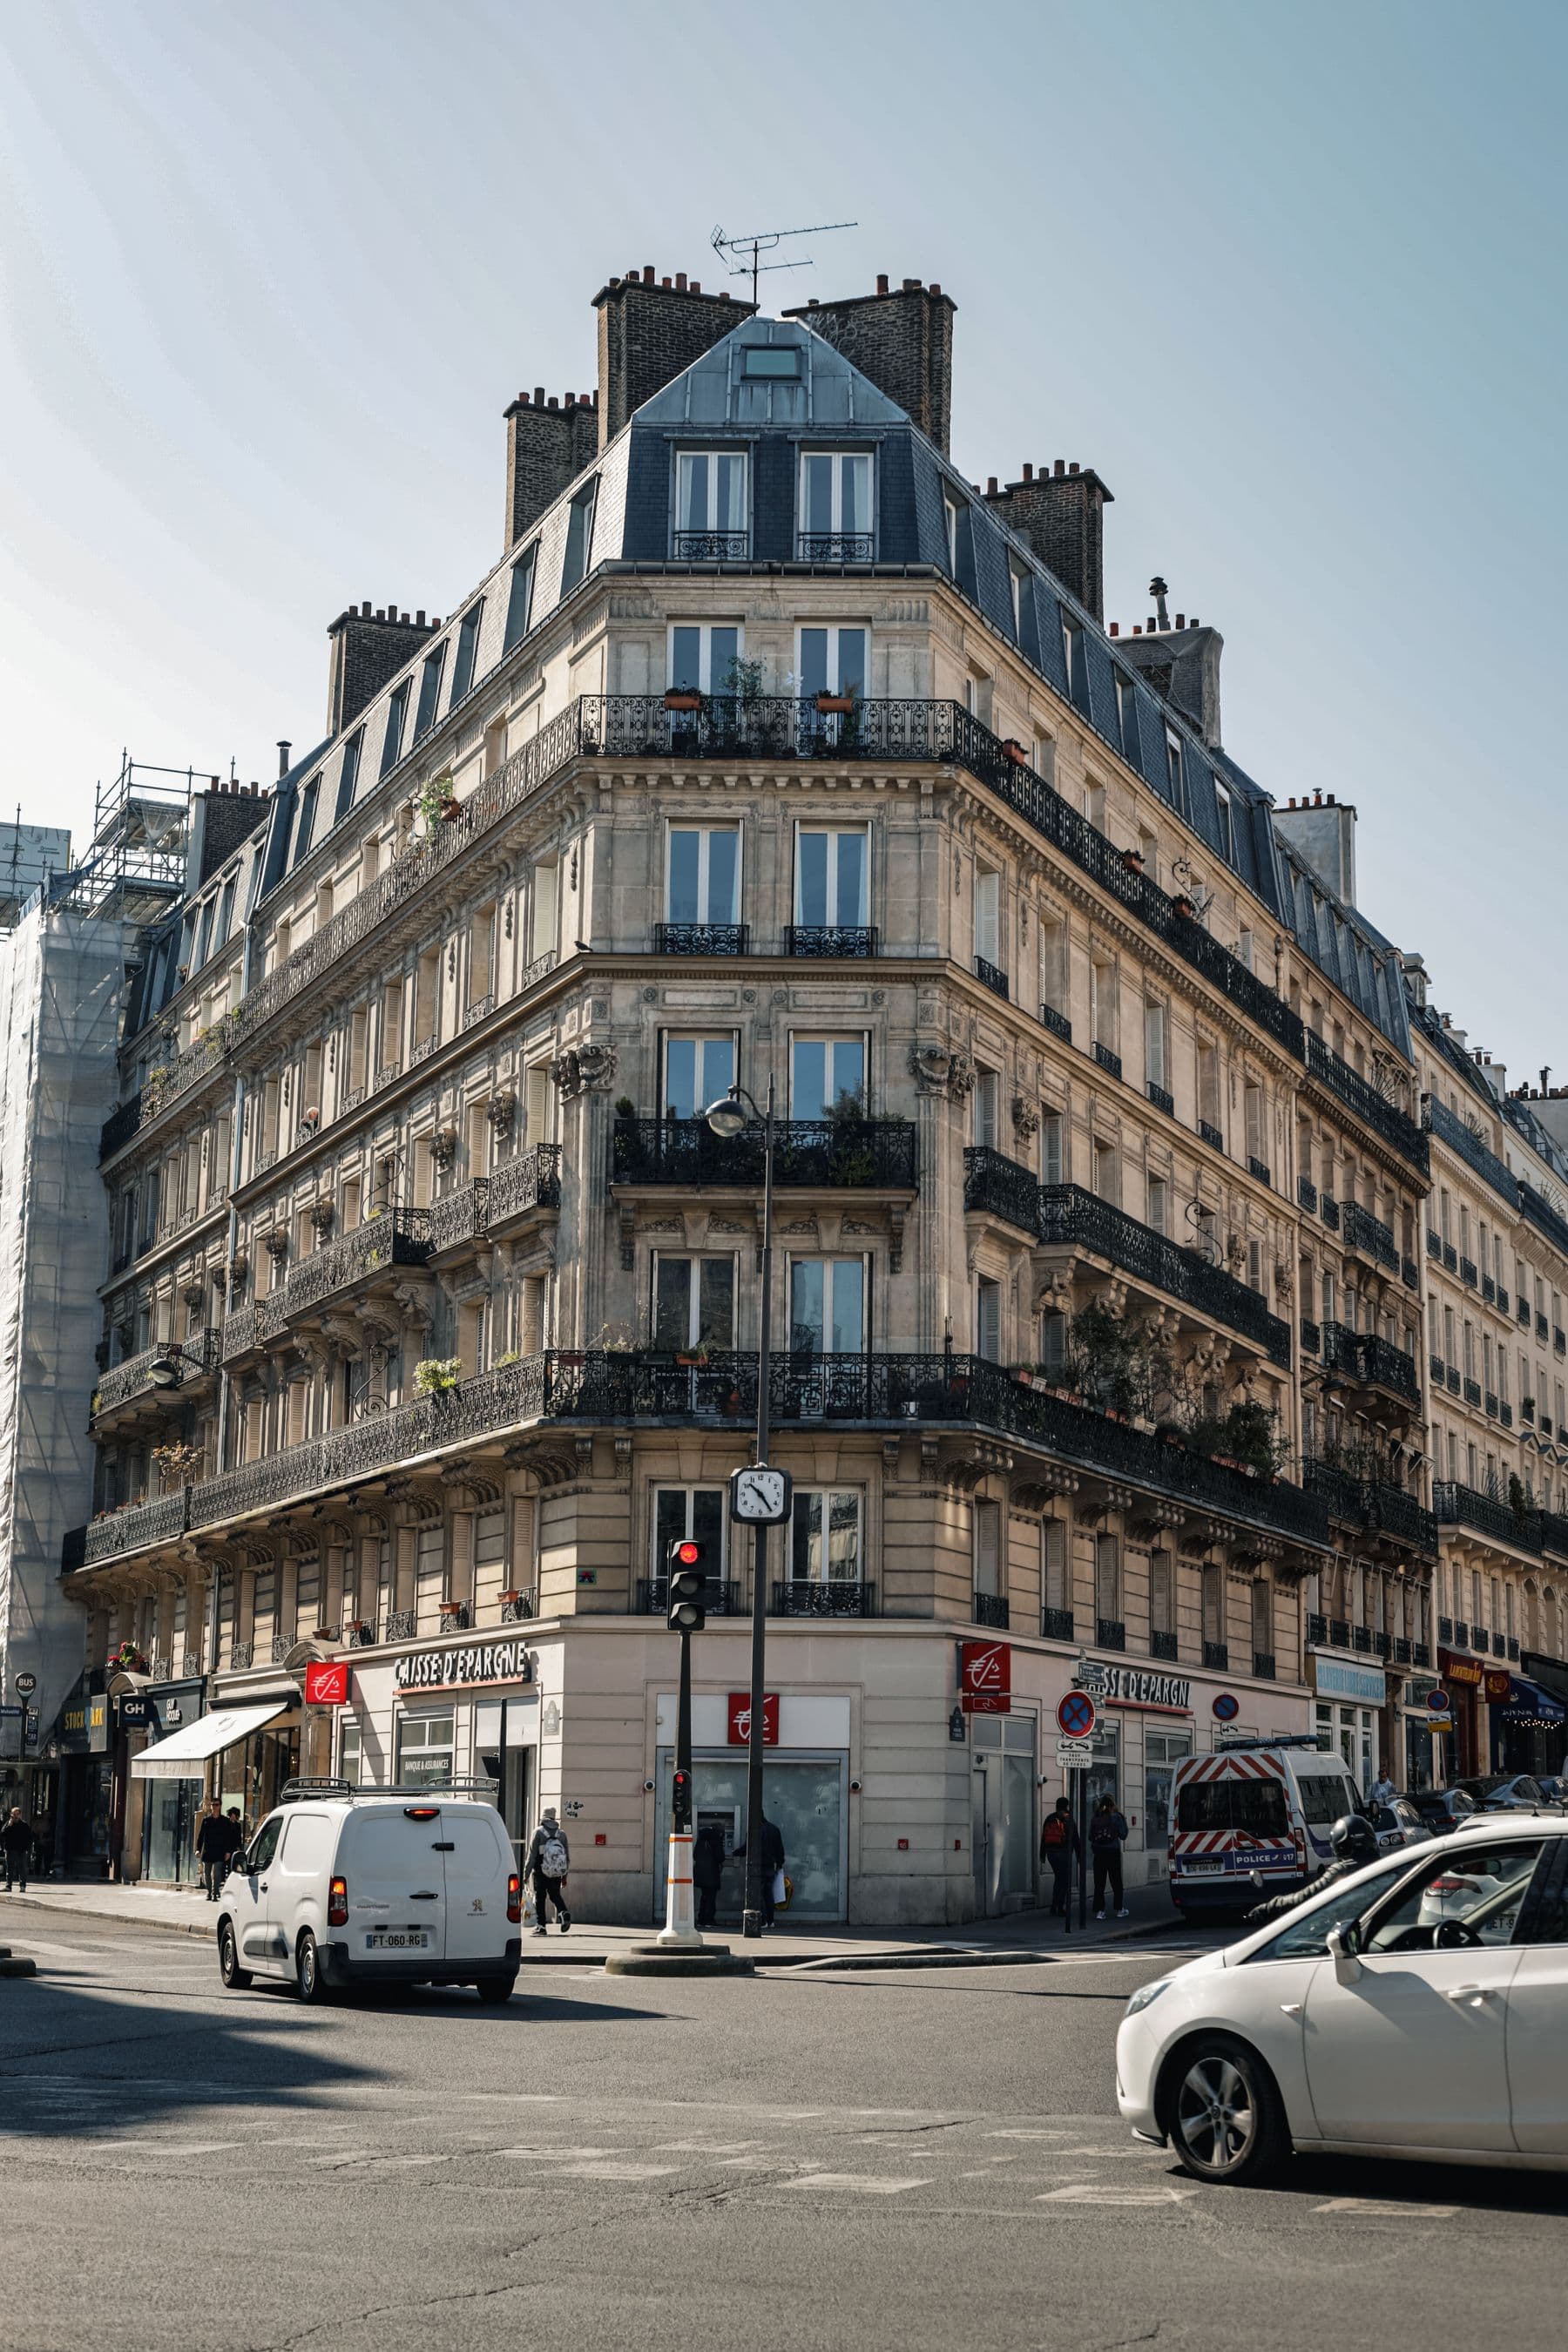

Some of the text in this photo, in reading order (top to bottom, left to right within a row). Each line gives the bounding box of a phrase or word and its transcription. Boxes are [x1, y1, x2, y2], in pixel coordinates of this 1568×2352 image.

[394, 1653, 440, 1685] CAISSE
[18, 1678, 34, 1686] BUS
[125, 1703, 145, 1714] GH
[64, 1710, 84, 1730] STOCK
[1237, 1855, 1271, 1863] POLICE
[373, 1935, 420, 1946] FT-060-RG
